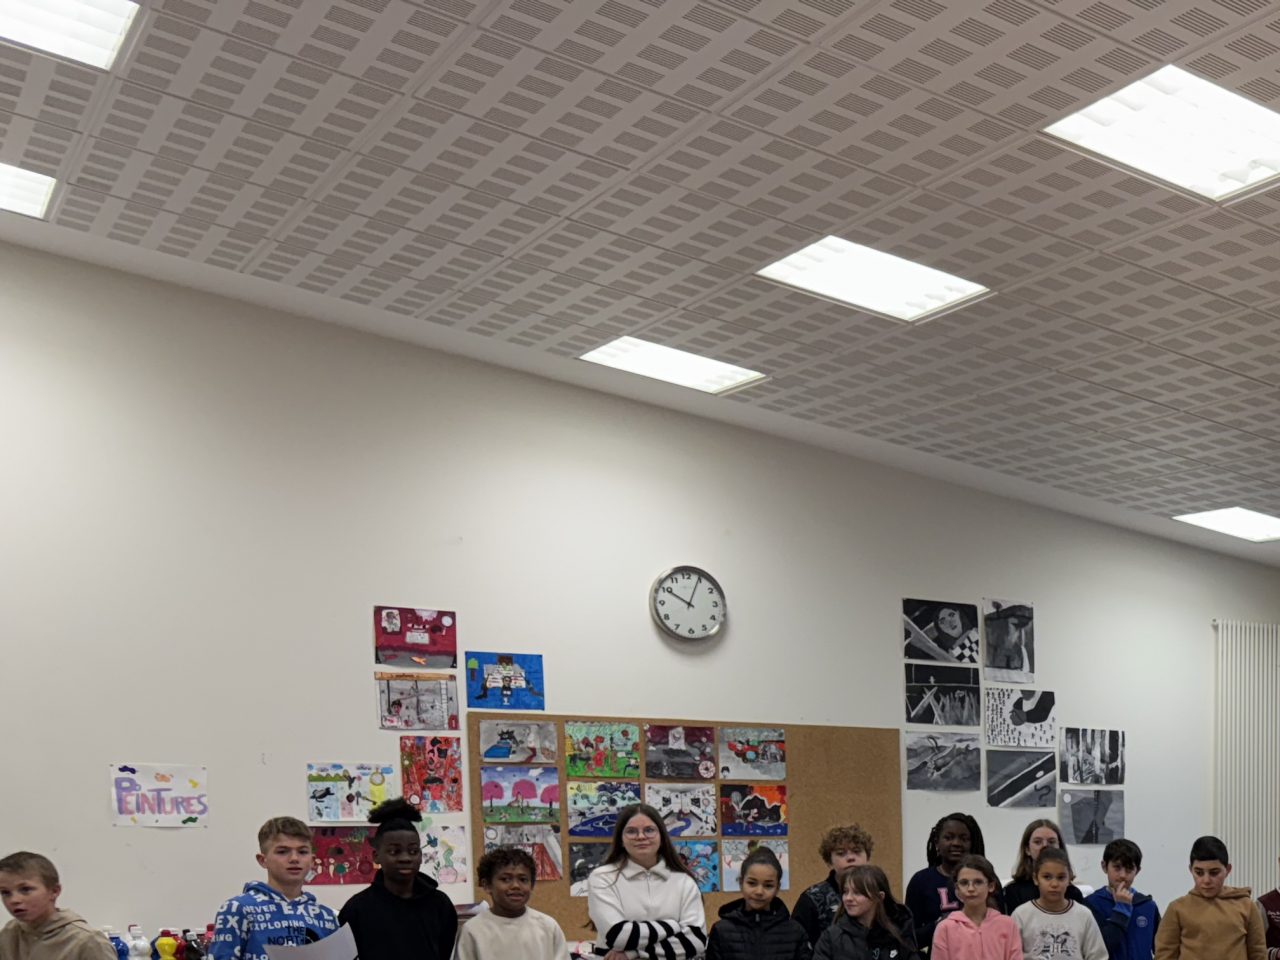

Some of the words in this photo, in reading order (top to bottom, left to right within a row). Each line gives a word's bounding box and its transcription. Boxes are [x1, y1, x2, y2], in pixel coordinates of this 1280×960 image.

[662, 586, 673, 594] 10
[674, 623, 681, 631] 7
[936, 887, 959, 912] L
